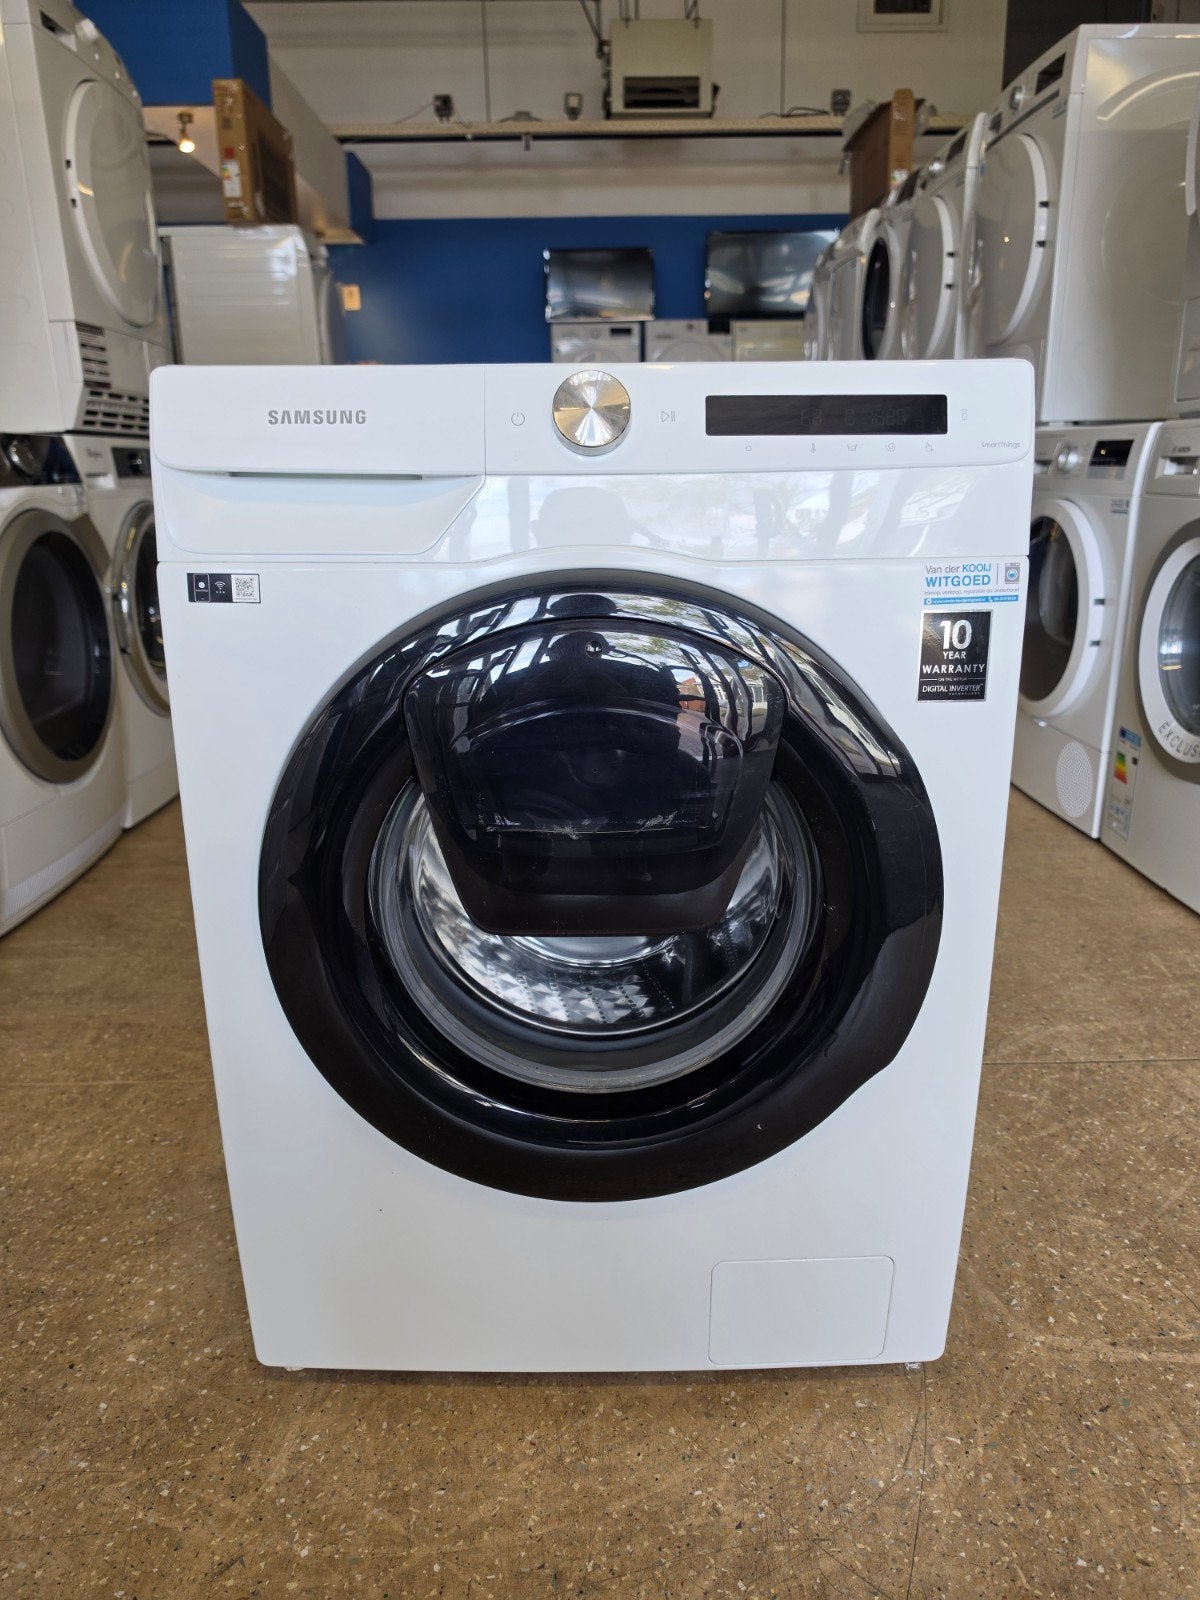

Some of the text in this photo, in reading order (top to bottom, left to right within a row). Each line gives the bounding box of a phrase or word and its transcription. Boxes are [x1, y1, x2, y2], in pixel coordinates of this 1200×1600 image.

[268, 409, 366, 425] SAMSUNG
[925, 563, 992, 574] Van der KOOIJ
[925, 575, 991, 587] WITGOED
[939, 619, 972, 650] 10
[942, 651, 967, 660] YEAR
[922, 664, 985, 674] WARRANTY
[922, 685, 948, 693] DIGITAL
[1158, 721, 1200, 758] EXCLUS
